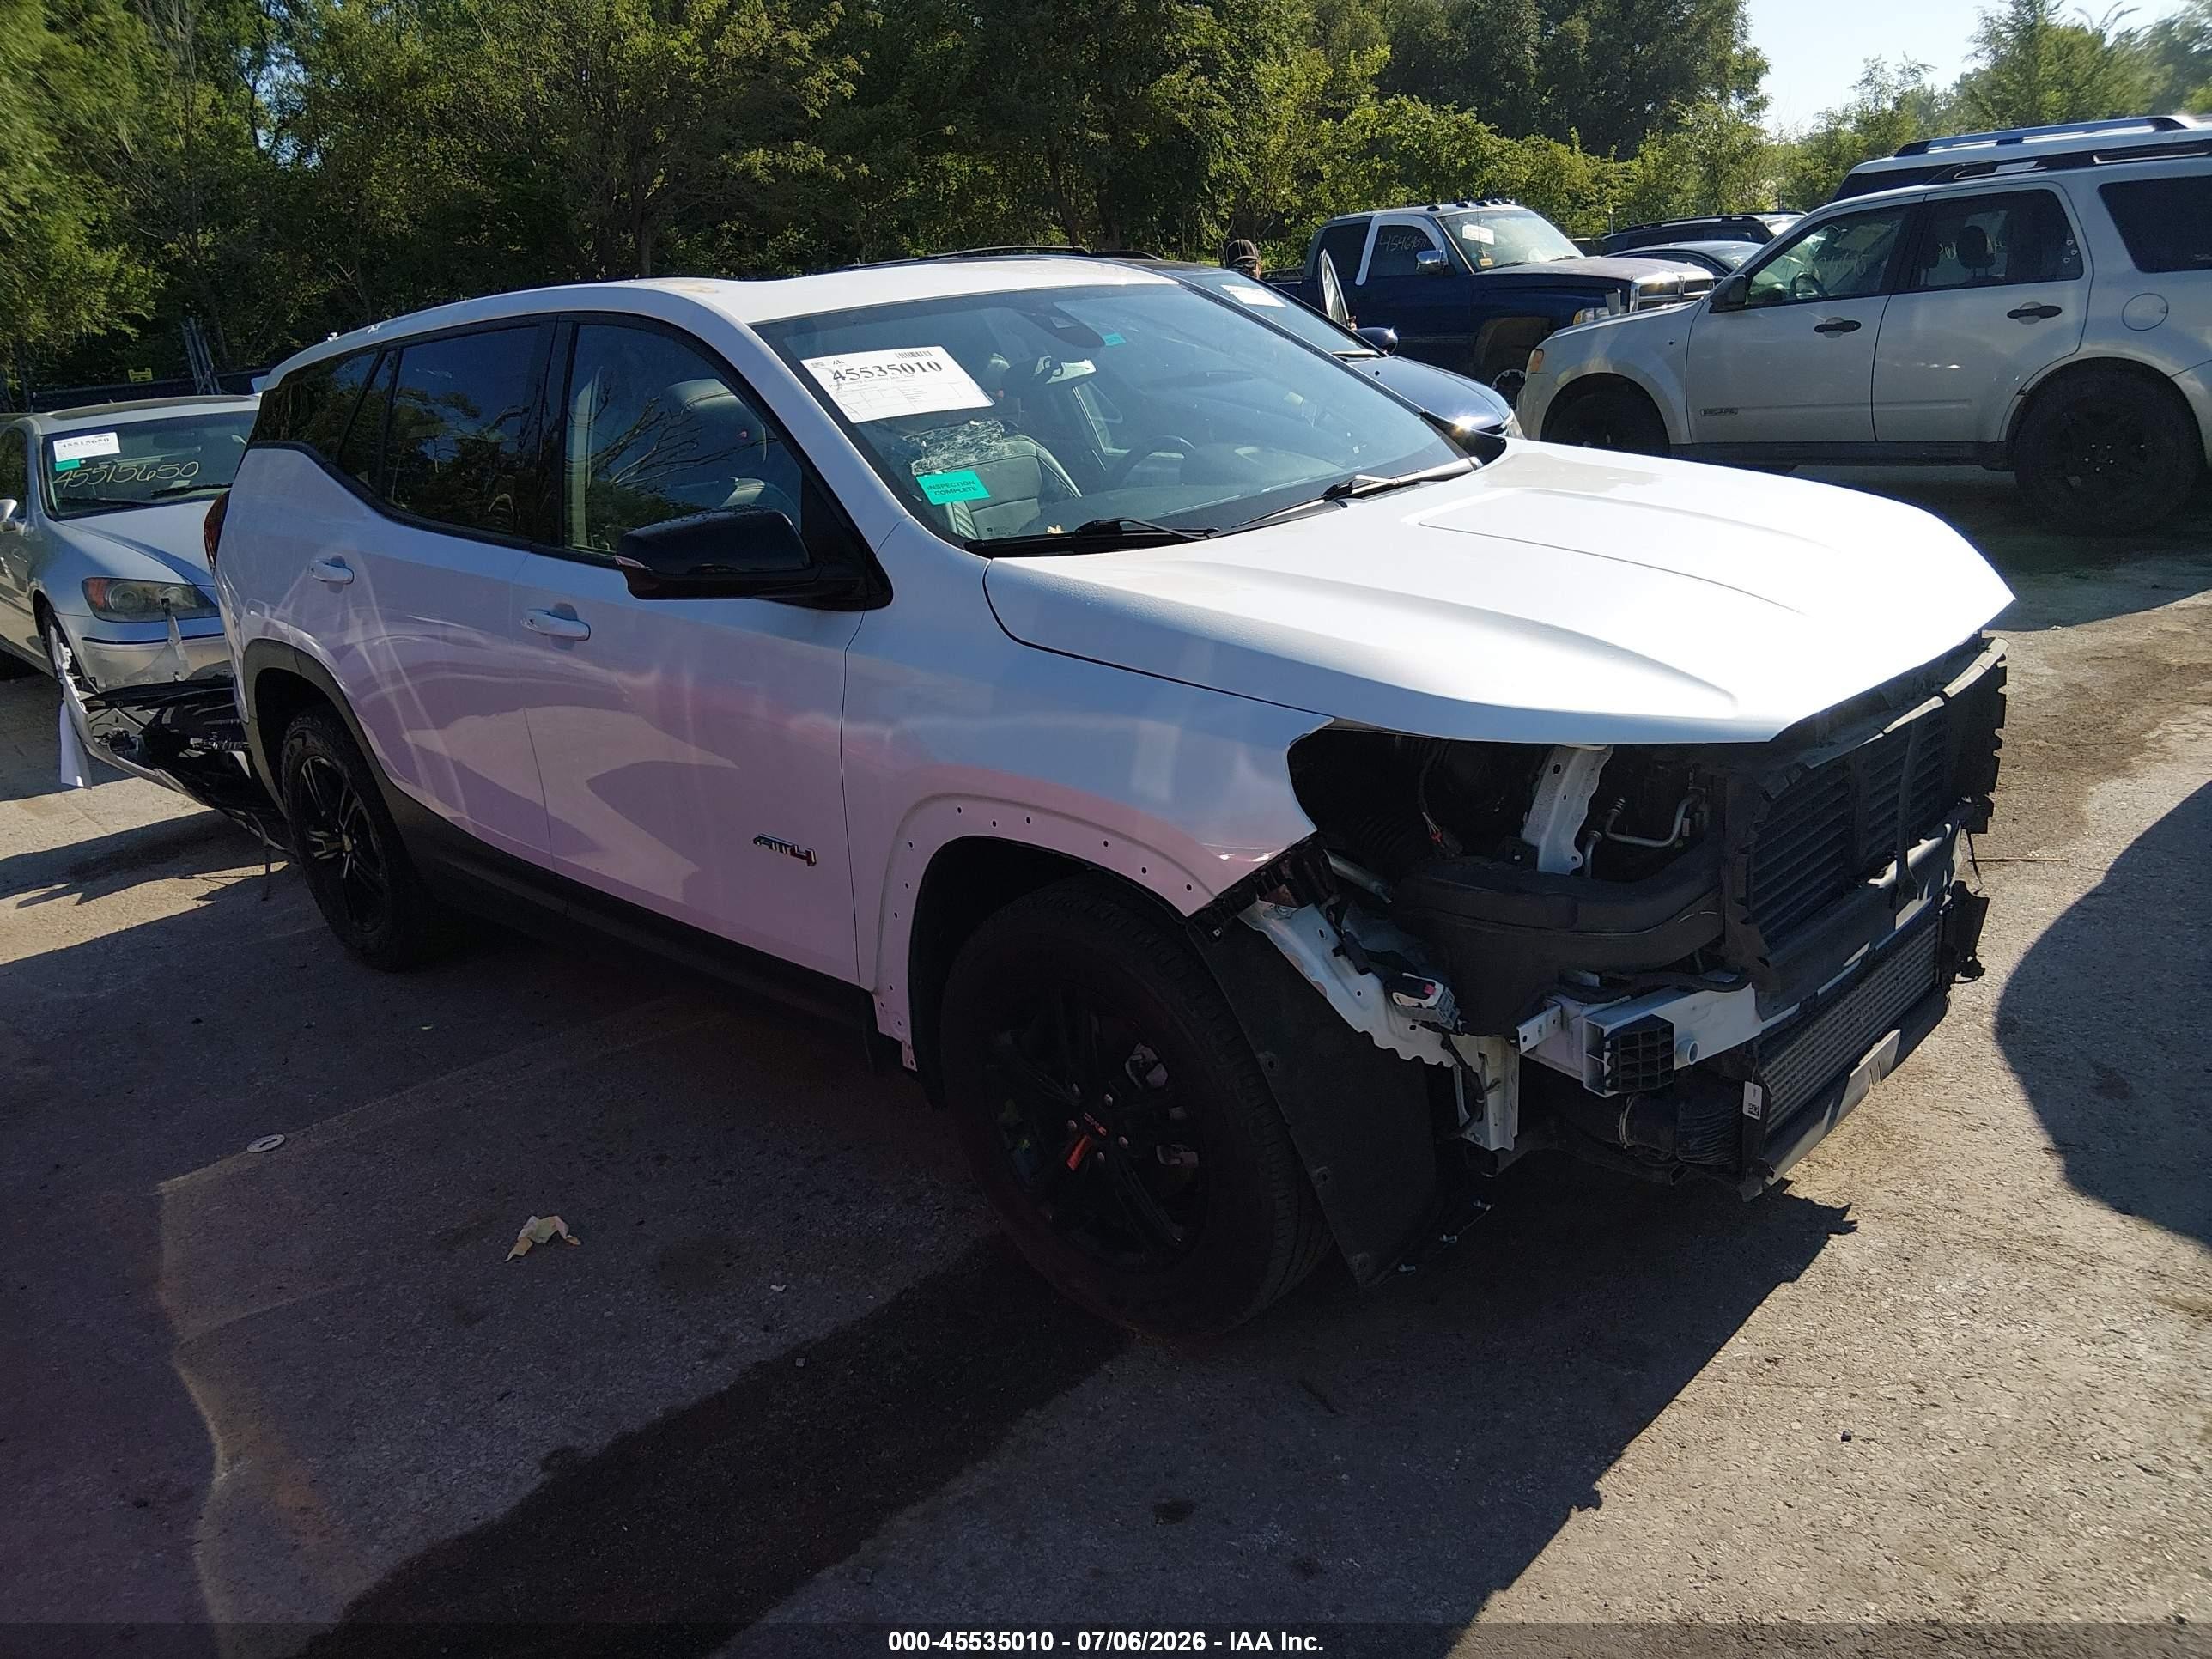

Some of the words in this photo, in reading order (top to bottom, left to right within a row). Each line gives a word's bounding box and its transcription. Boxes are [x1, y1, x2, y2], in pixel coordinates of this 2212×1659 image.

[833, 360, 943, 381] 45535010
[53, 461, 199, 489] 45515650
[927, 480, 975, 490] INSPECTION
[934, 486, 978, 496] COMPLETE
[753, 833, 817, 866] AT4
